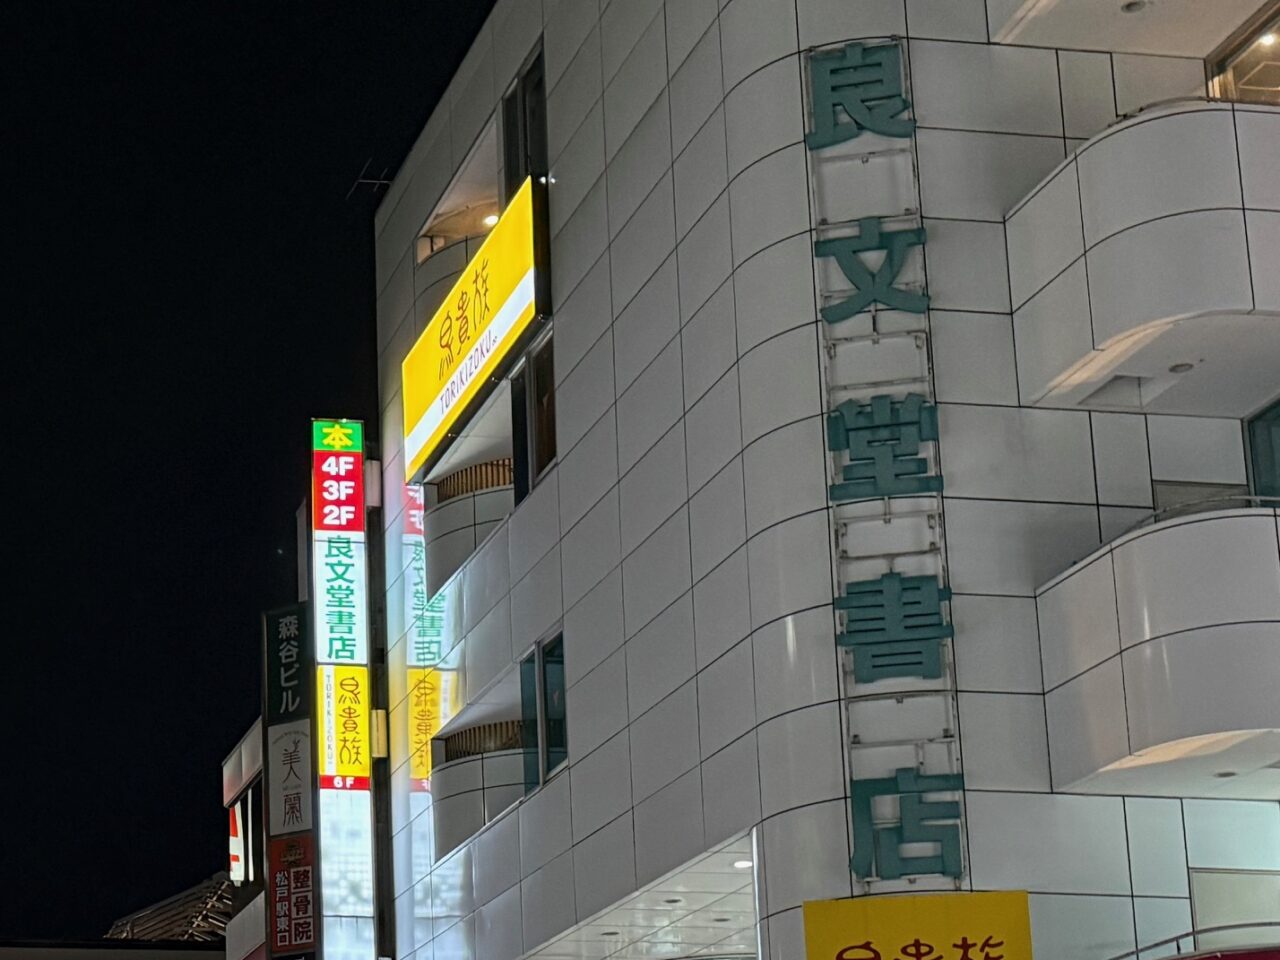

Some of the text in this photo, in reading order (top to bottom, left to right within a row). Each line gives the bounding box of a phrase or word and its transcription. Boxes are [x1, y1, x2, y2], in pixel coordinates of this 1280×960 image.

[439, 330, 494, 414] TORIKIZOKU
[322, 423, 354, 449] 本
[322, 456, 354, 476] 4F
[806, 41, 966, 882] 良文堂書店
[322, 481, 355, 501] 3F
[322, 505, 355, 525] 2F
[324, 535, 357, 660] 良文堂書店
[278, 615, 300, 714] 森谷ビル
[333, 776, 355, 788] 6F
[276, 871, 289, 946] 松戸駅東口
[291, 866, 313, 944] 整骨院
